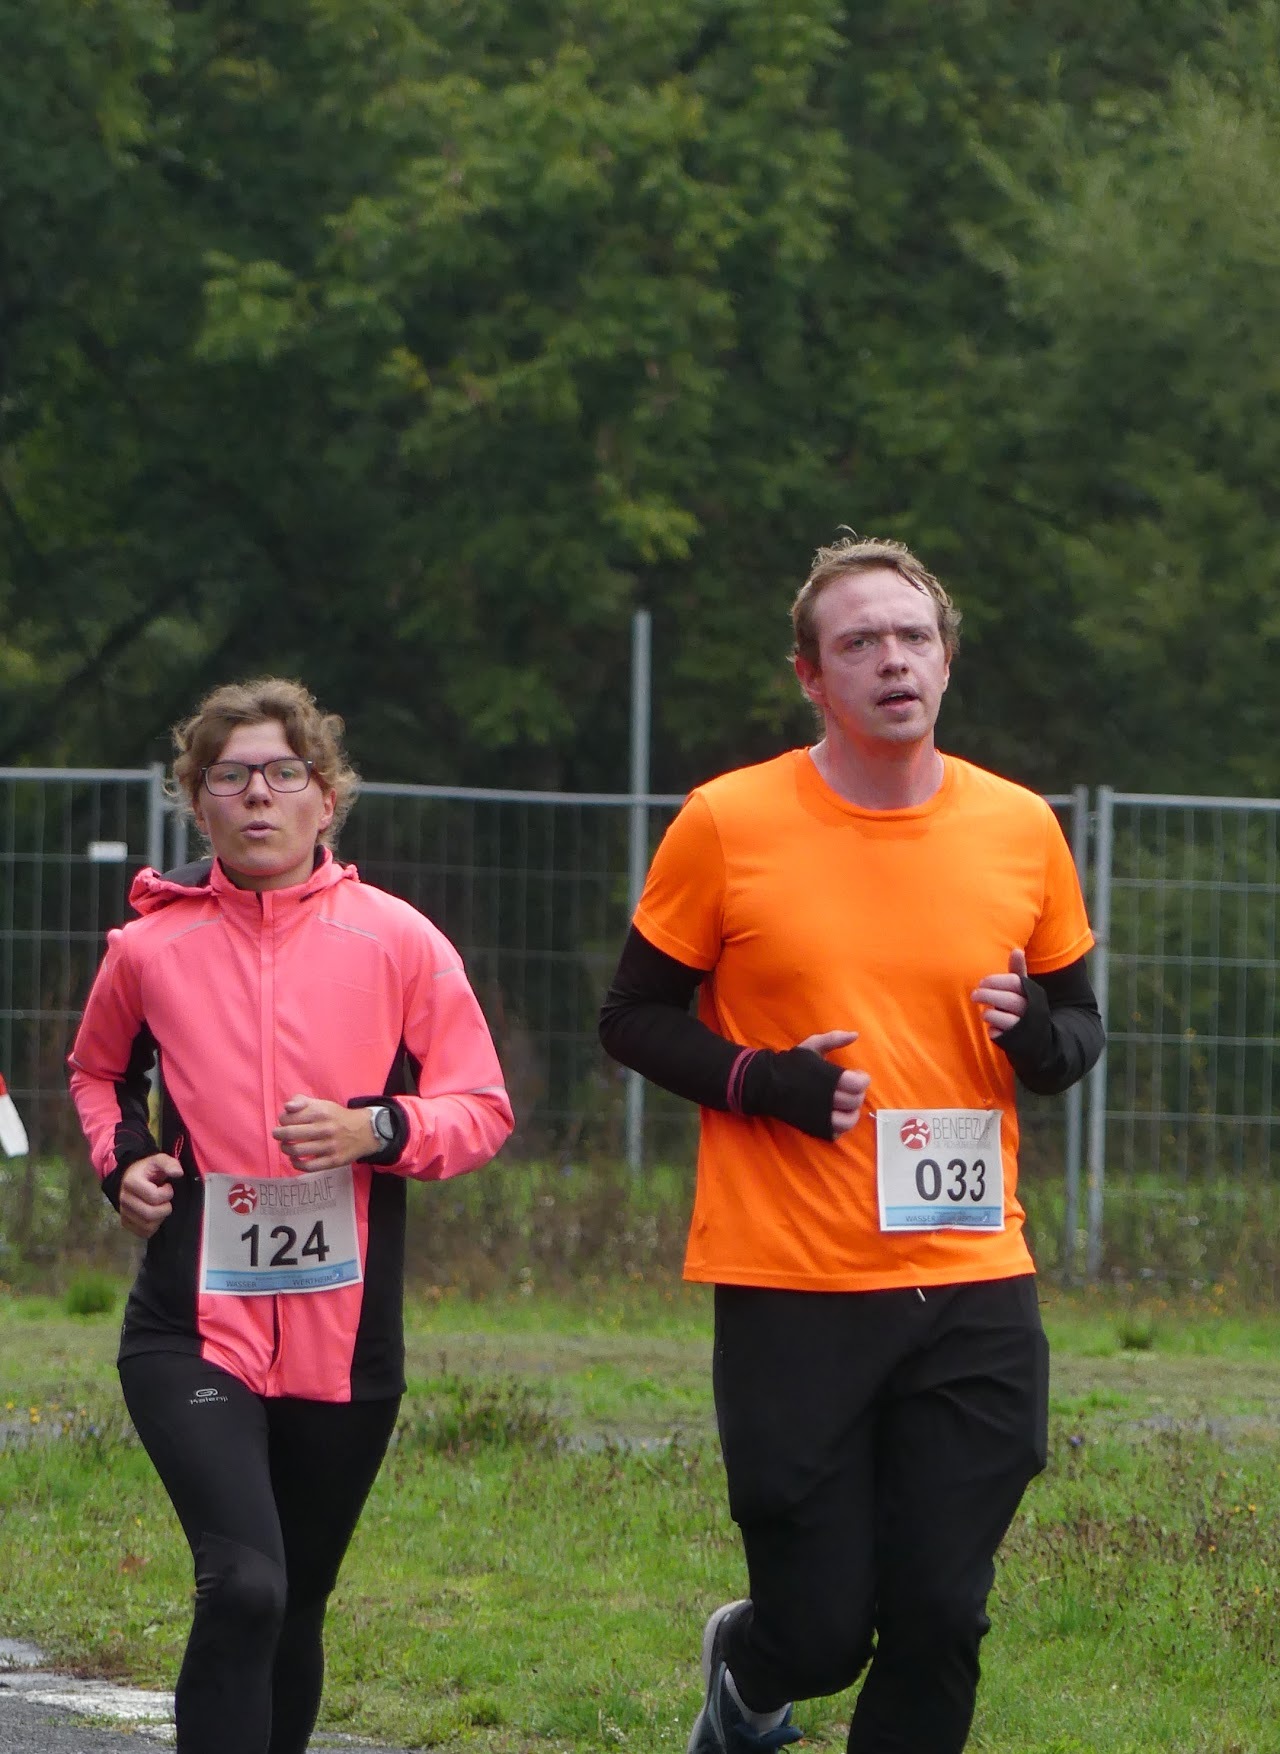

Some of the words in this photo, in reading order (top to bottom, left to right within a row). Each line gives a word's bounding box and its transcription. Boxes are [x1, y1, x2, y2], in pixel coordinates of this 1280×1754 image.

[259, 1176, 334, 1207] BENEFIZLAUF
[915, 1158, 986, 1202] 033
[241, 1220, 330, 1267] 124
[226, 1280, 257, 1288] WASSER
[292, 1275, 333, 1287] WERTHEIM
